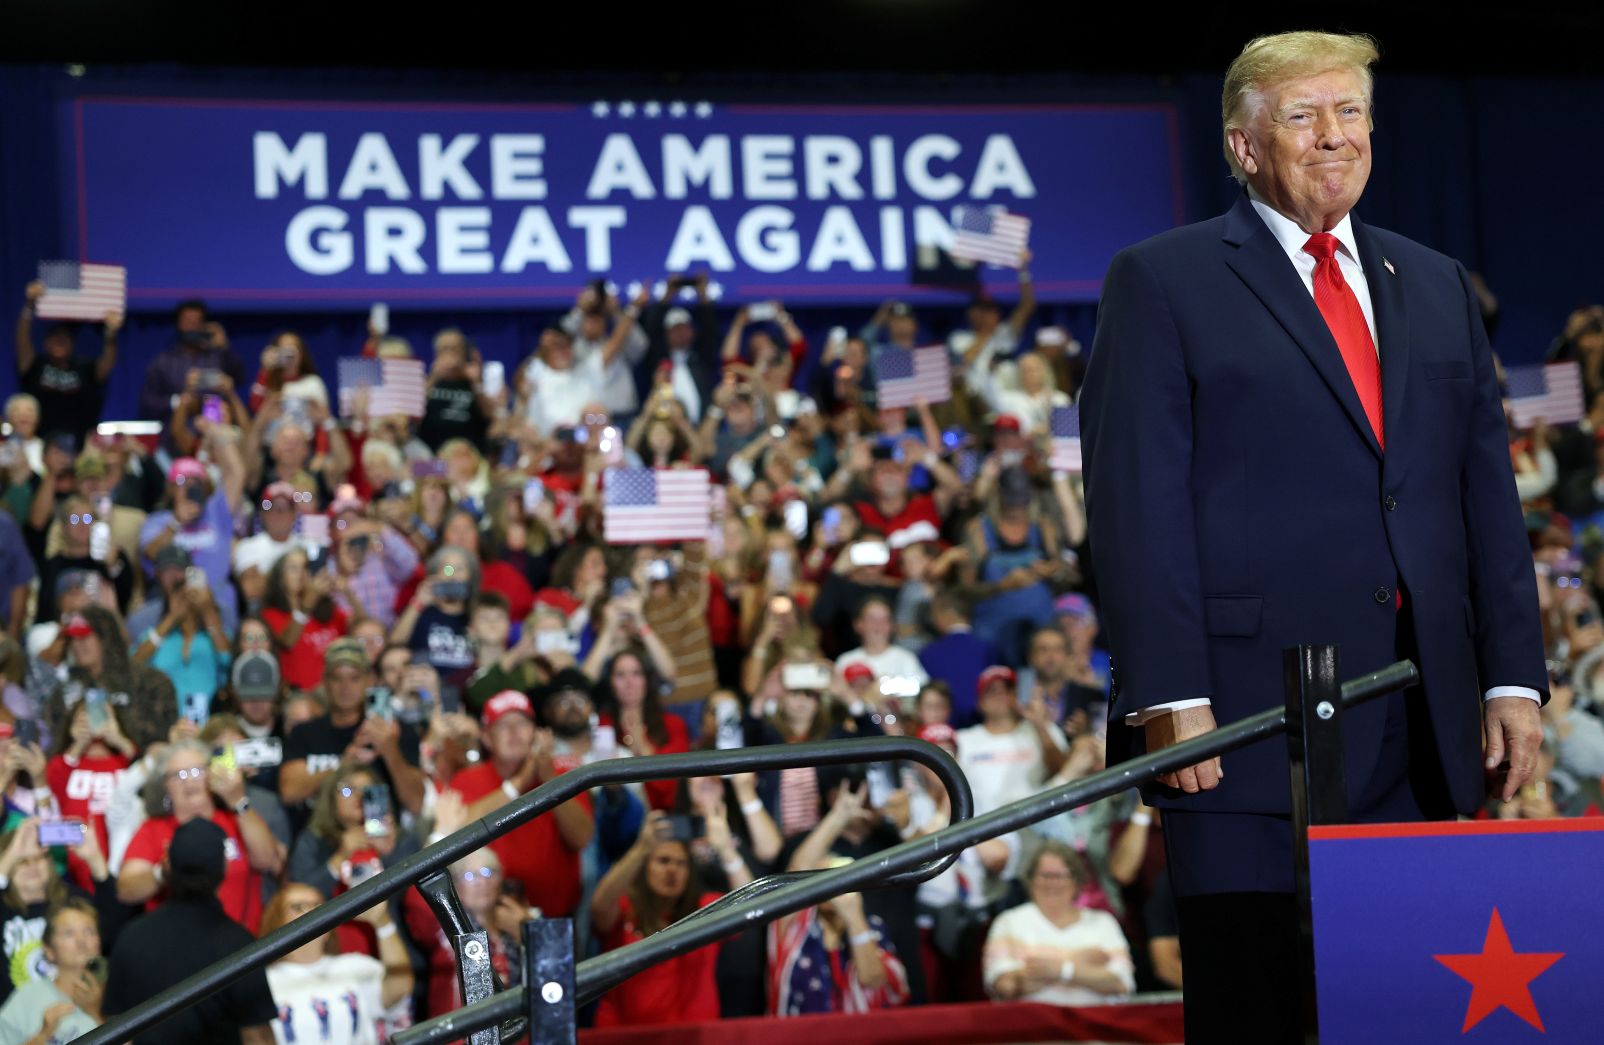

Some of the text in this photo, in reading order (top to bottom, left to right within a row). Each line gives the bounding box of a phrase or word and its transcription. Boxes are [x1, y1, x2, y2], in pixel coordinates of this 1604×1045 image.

[253, 133, 1034, 200] MAKE AMERICA
[286, 205, 626, 275] GREAT
